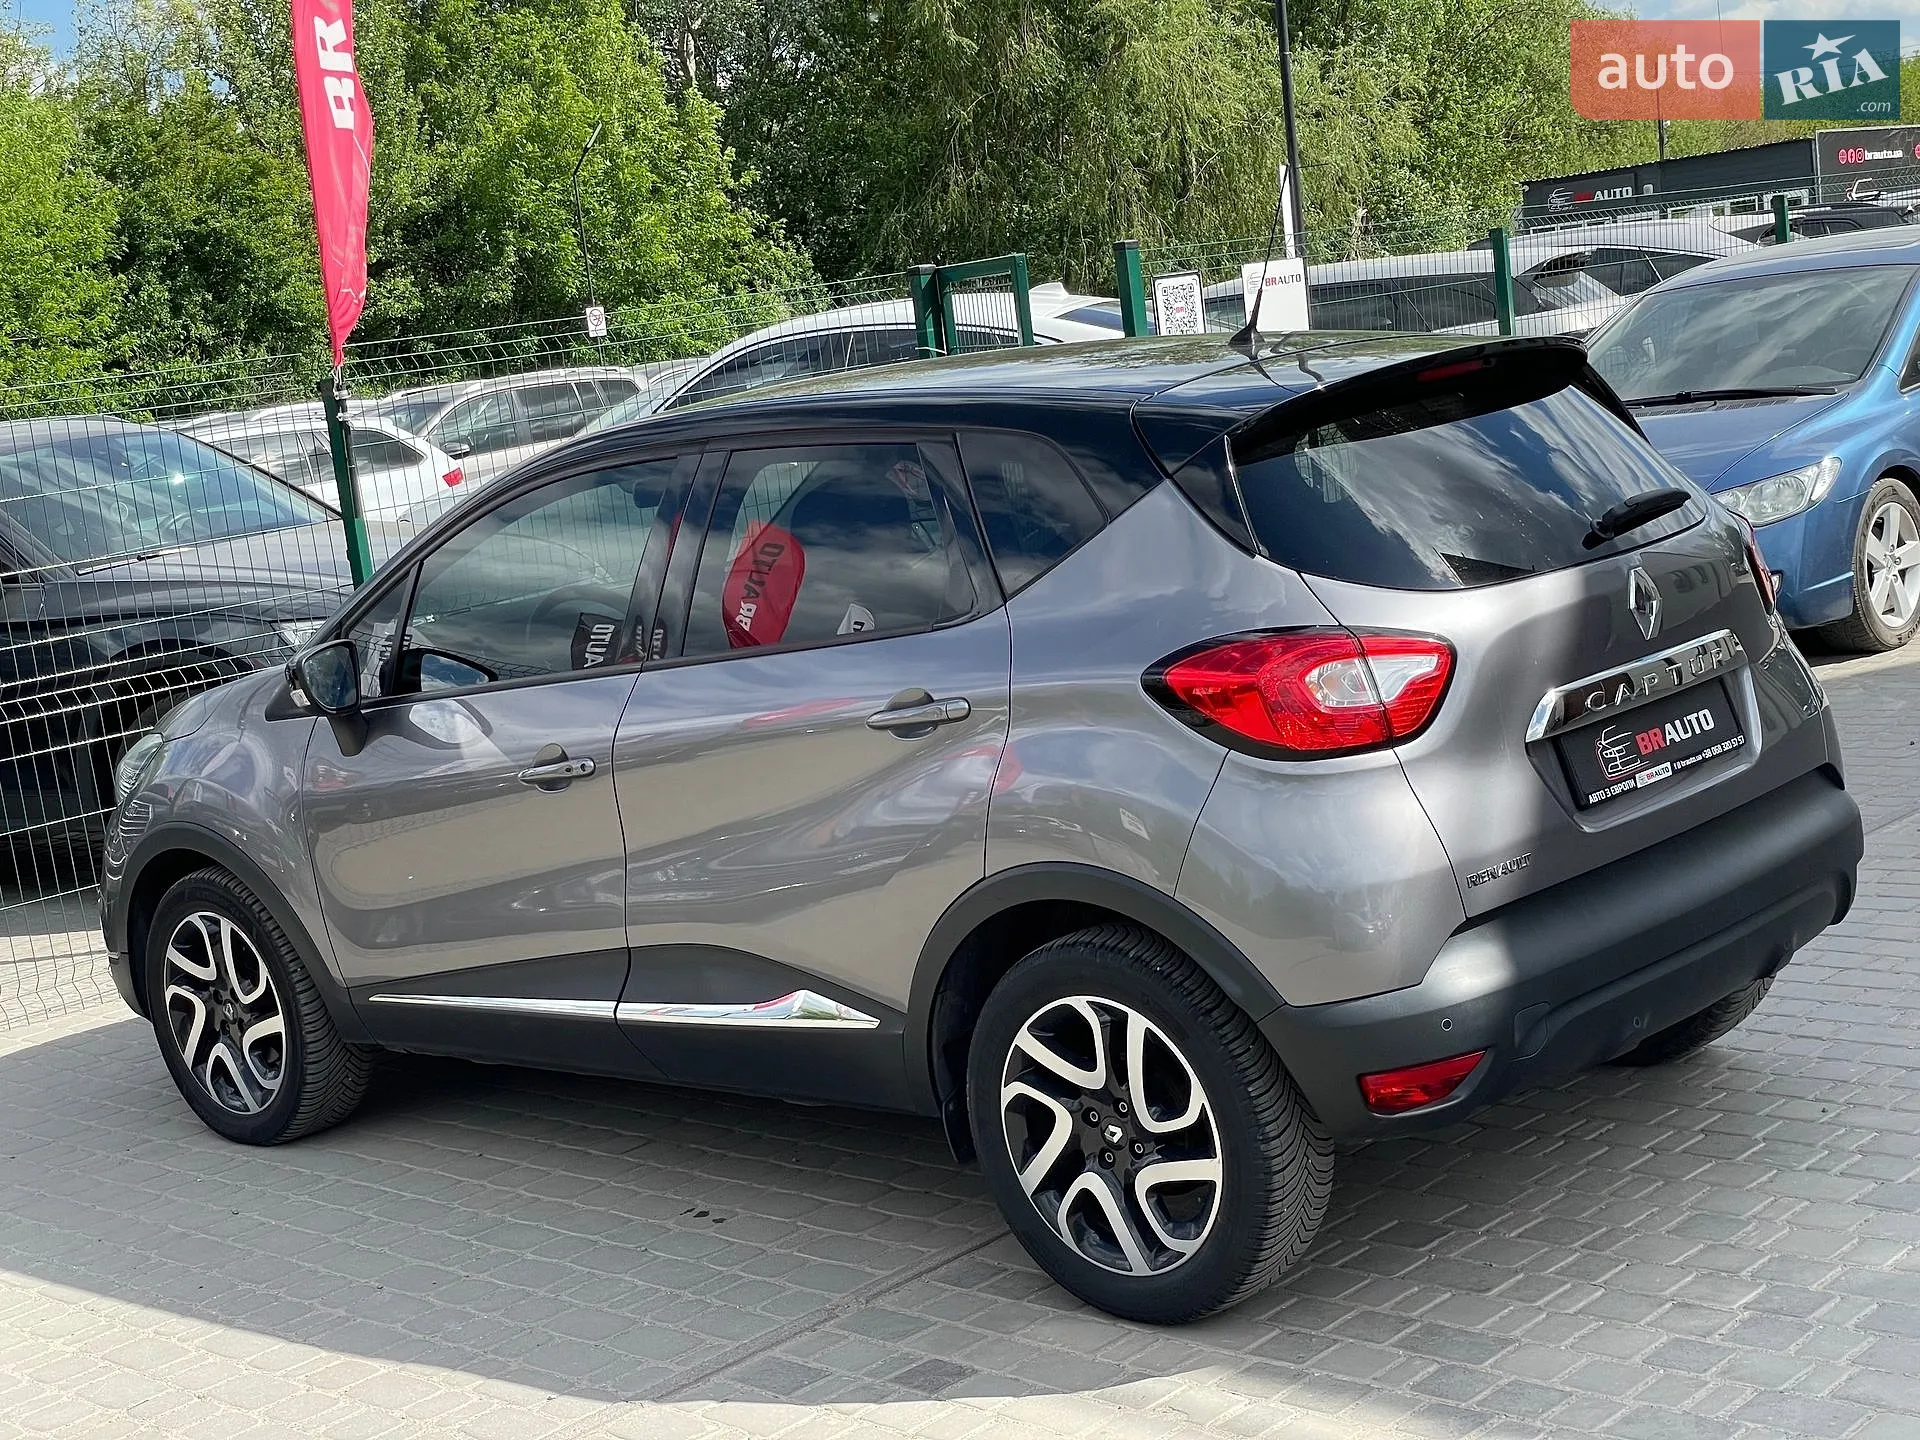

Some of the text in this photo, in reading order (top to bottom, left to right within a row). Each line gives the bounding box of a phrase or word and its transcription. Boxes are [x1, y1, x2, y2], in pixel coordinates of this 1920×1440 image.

[1265, 273, 1302, 287] BRAUTO
[1584, 647, 1724, 712] CAPTUR
[1635, 708, 1715, 756] BRAUTO
[1646, 767, 1670, 780] BRAUTO
[1466, 852, 1532, 888] RENAULT
